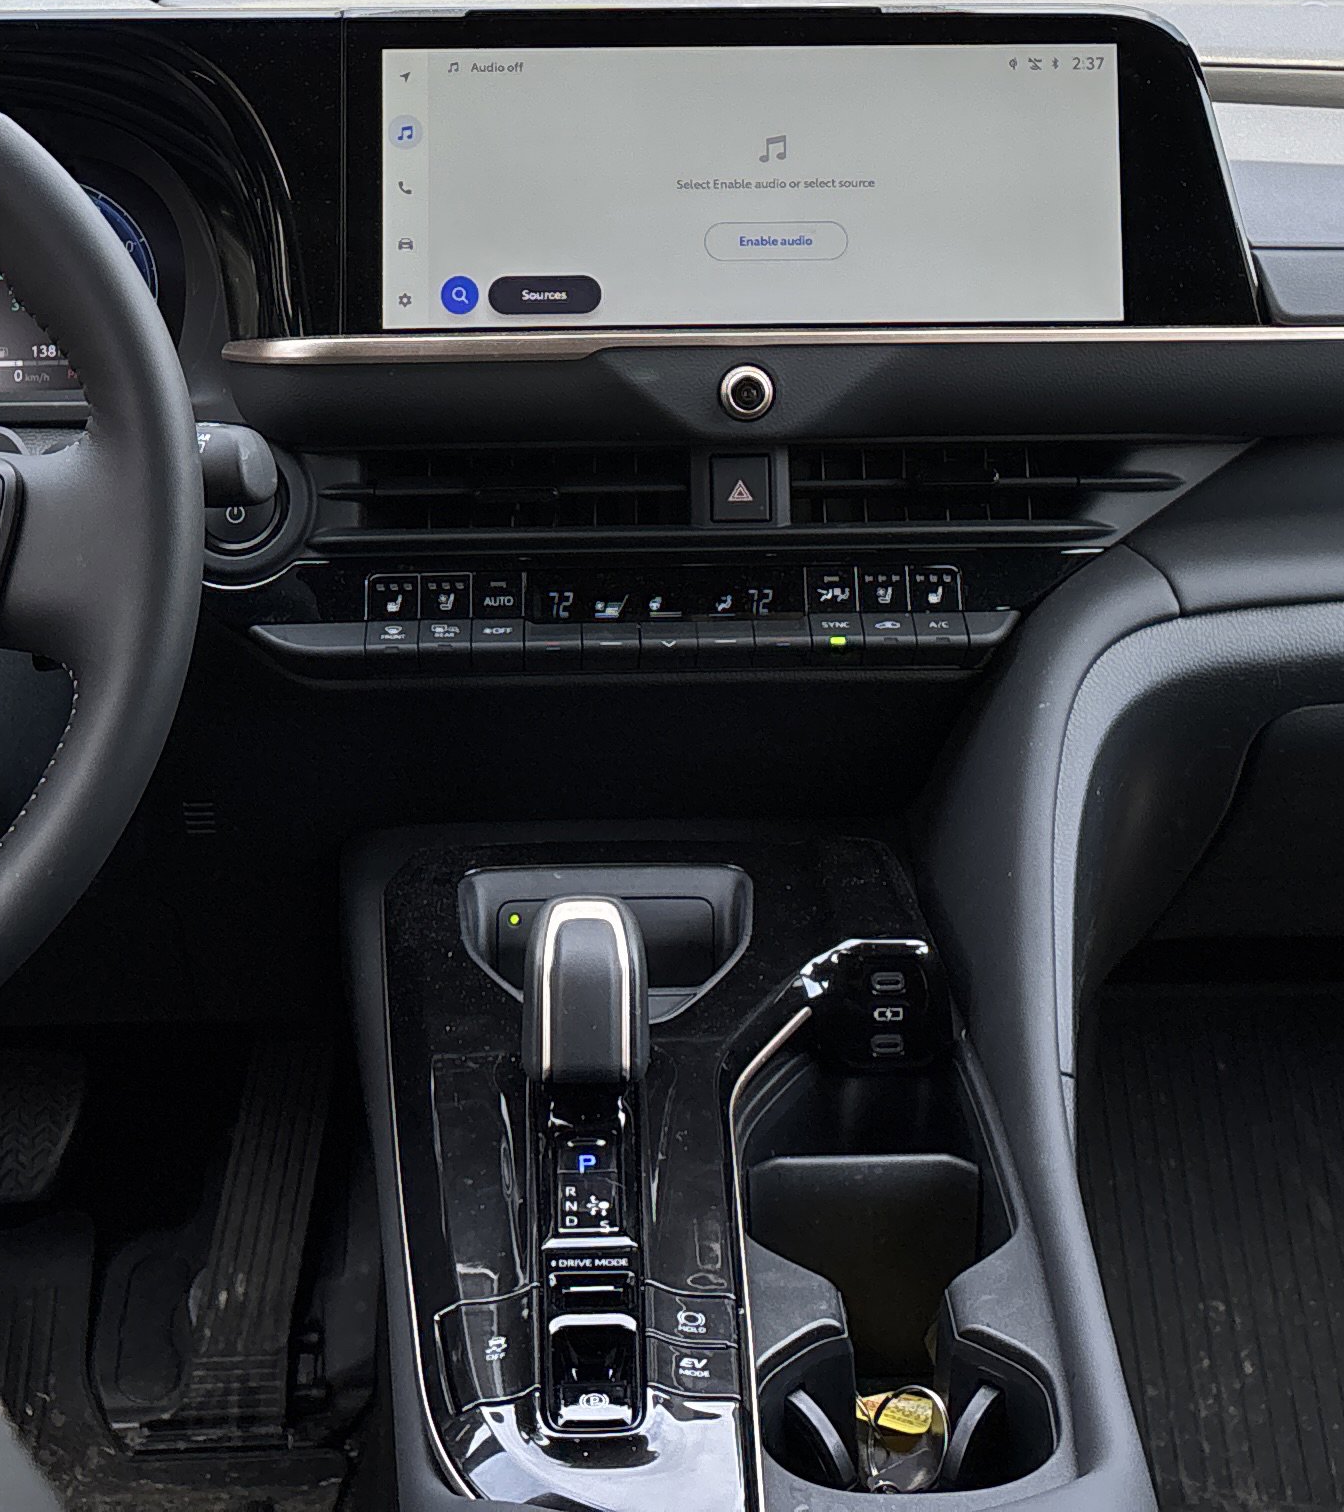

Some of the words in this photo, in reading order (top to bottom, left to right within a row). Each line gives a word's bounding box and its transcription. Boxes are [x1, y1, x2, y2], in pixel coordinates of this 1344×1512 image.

[470, 62, 505, 73] Audio
[507, 61, 524, 73] off
[1072, 56, 1104, 70] 2:37
[676, 179, 711, 190] Select
[713, 178, 752, 189] Enable
[754, 178, 787, 189] audio
[788, 180, 800, 188] or
[803, 178, 837, 189] select
[838, 179, 876, 188] source
[739, 236, 778, 247] Enable
[780, 235, 813, 246] audio
[521, 289, 568, 300] Sources
[31, 345, 57, 357] 138
[13, 370, 23, 382] 0
[25, 372, 50, 382] km/h
[483, 596, 514, 606] AUTO
[549, 591, 574, 618] 72
[749, 589, 773, 615] 72
[821, 621, 850, 629] SYNC
[929, 620, 949, 629] A/C
[578, 1154, 596, 1174] P
[565, 1186, 576, 1197] R
[565, 1200, 578, 1212] N
[565, 1215, 578, 1226] D
[558, 1258, 592, 1268] DRIVE
[594, 1257, 629, 1267] MODE
[679, 1357, 708, 1369] EV
[678, 1368, 710, 1378] MODE
